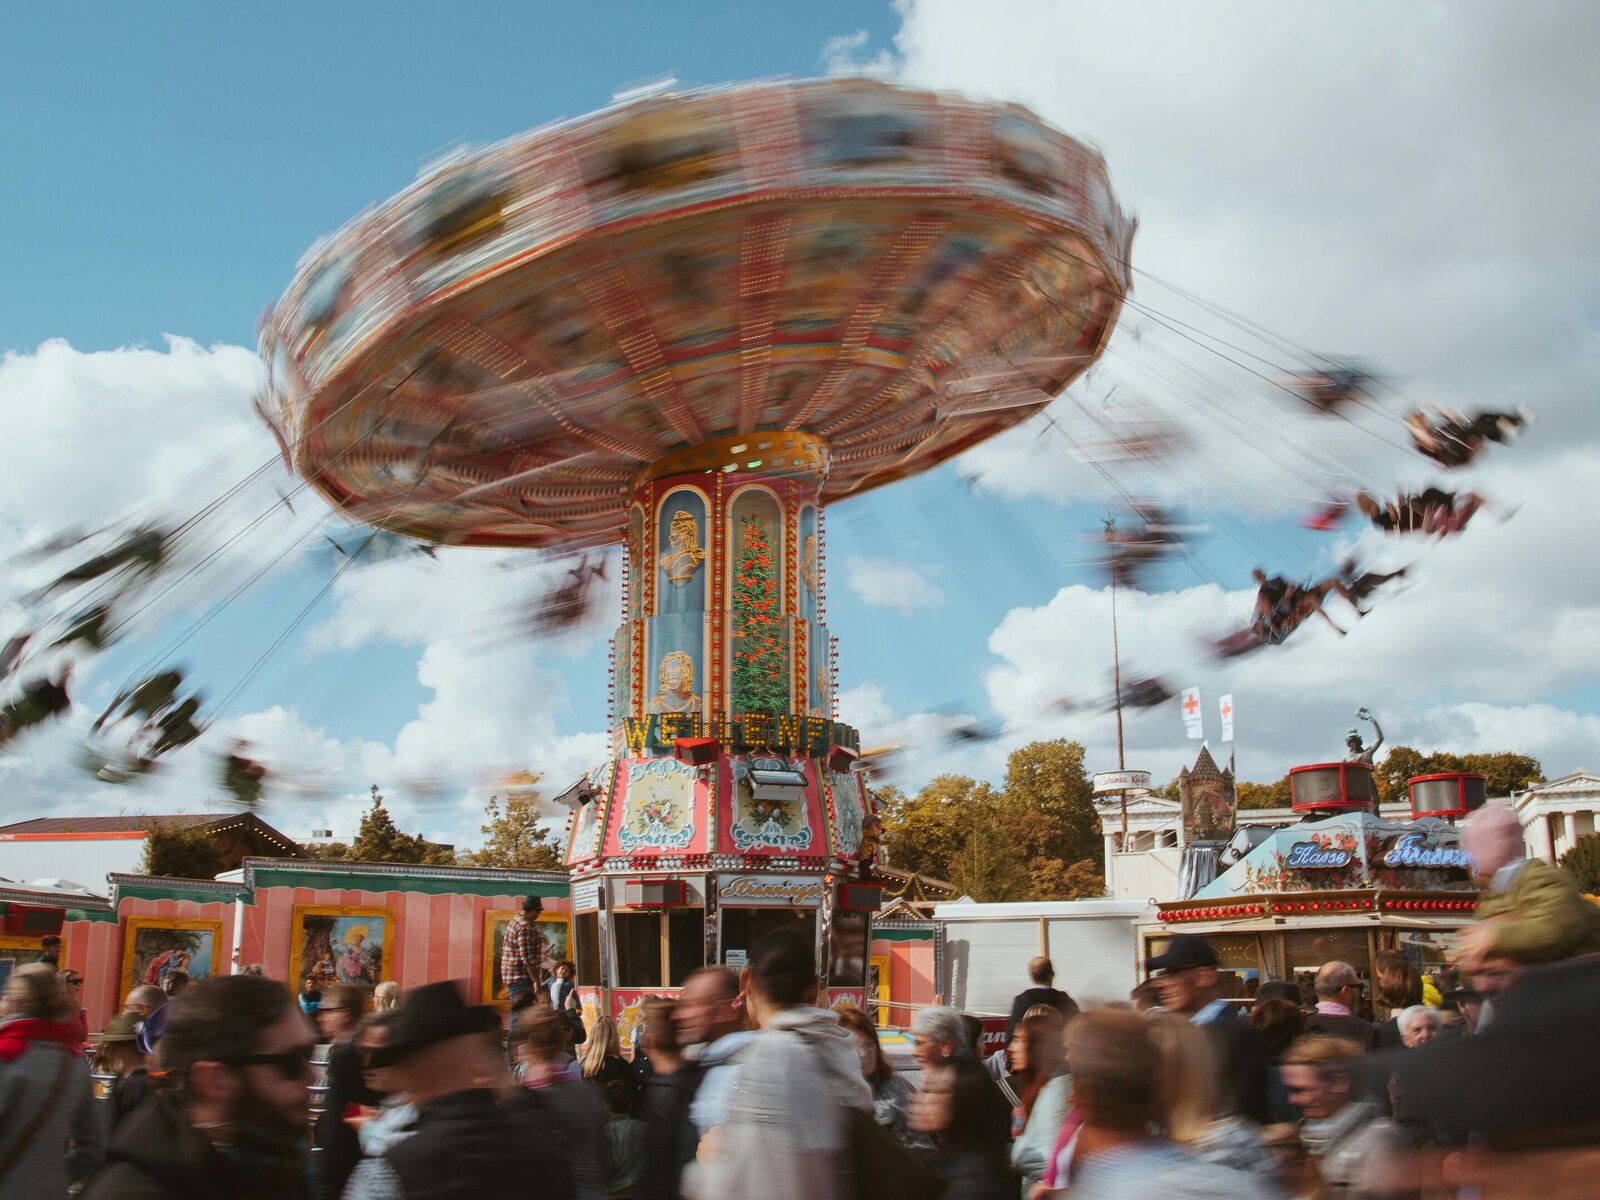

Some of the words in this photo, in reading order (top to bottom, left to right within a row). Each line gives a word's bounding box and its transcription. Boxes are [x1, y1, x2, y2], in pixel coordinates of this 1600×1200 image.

[622, 711, 834, 751] WELLENF
[1289, 846, 1346, 865] Kasse
[720, 877, 824, 905] Stranninger
